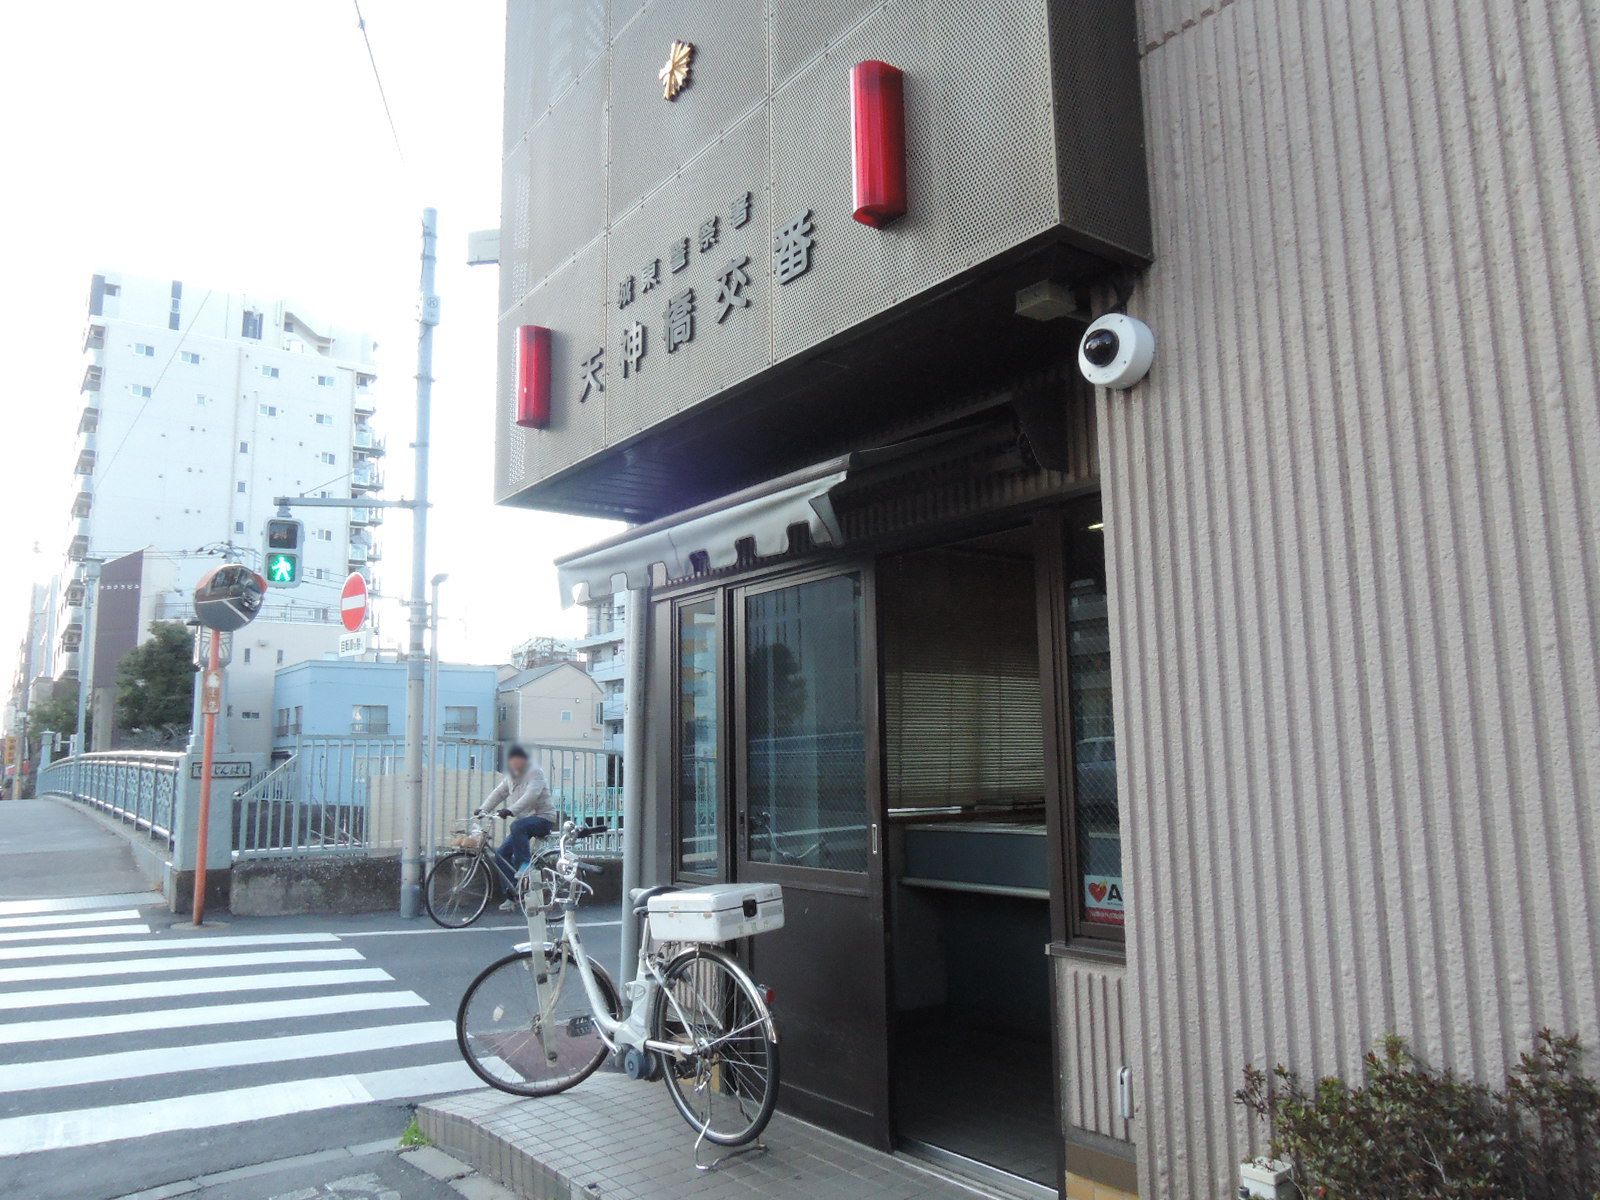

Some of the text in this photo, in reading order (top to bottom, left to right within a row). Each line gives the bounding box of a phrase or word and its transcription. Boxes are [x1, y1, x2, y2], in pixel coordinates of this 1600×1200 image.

[580, 207, 815, 402] 天神橋交番
